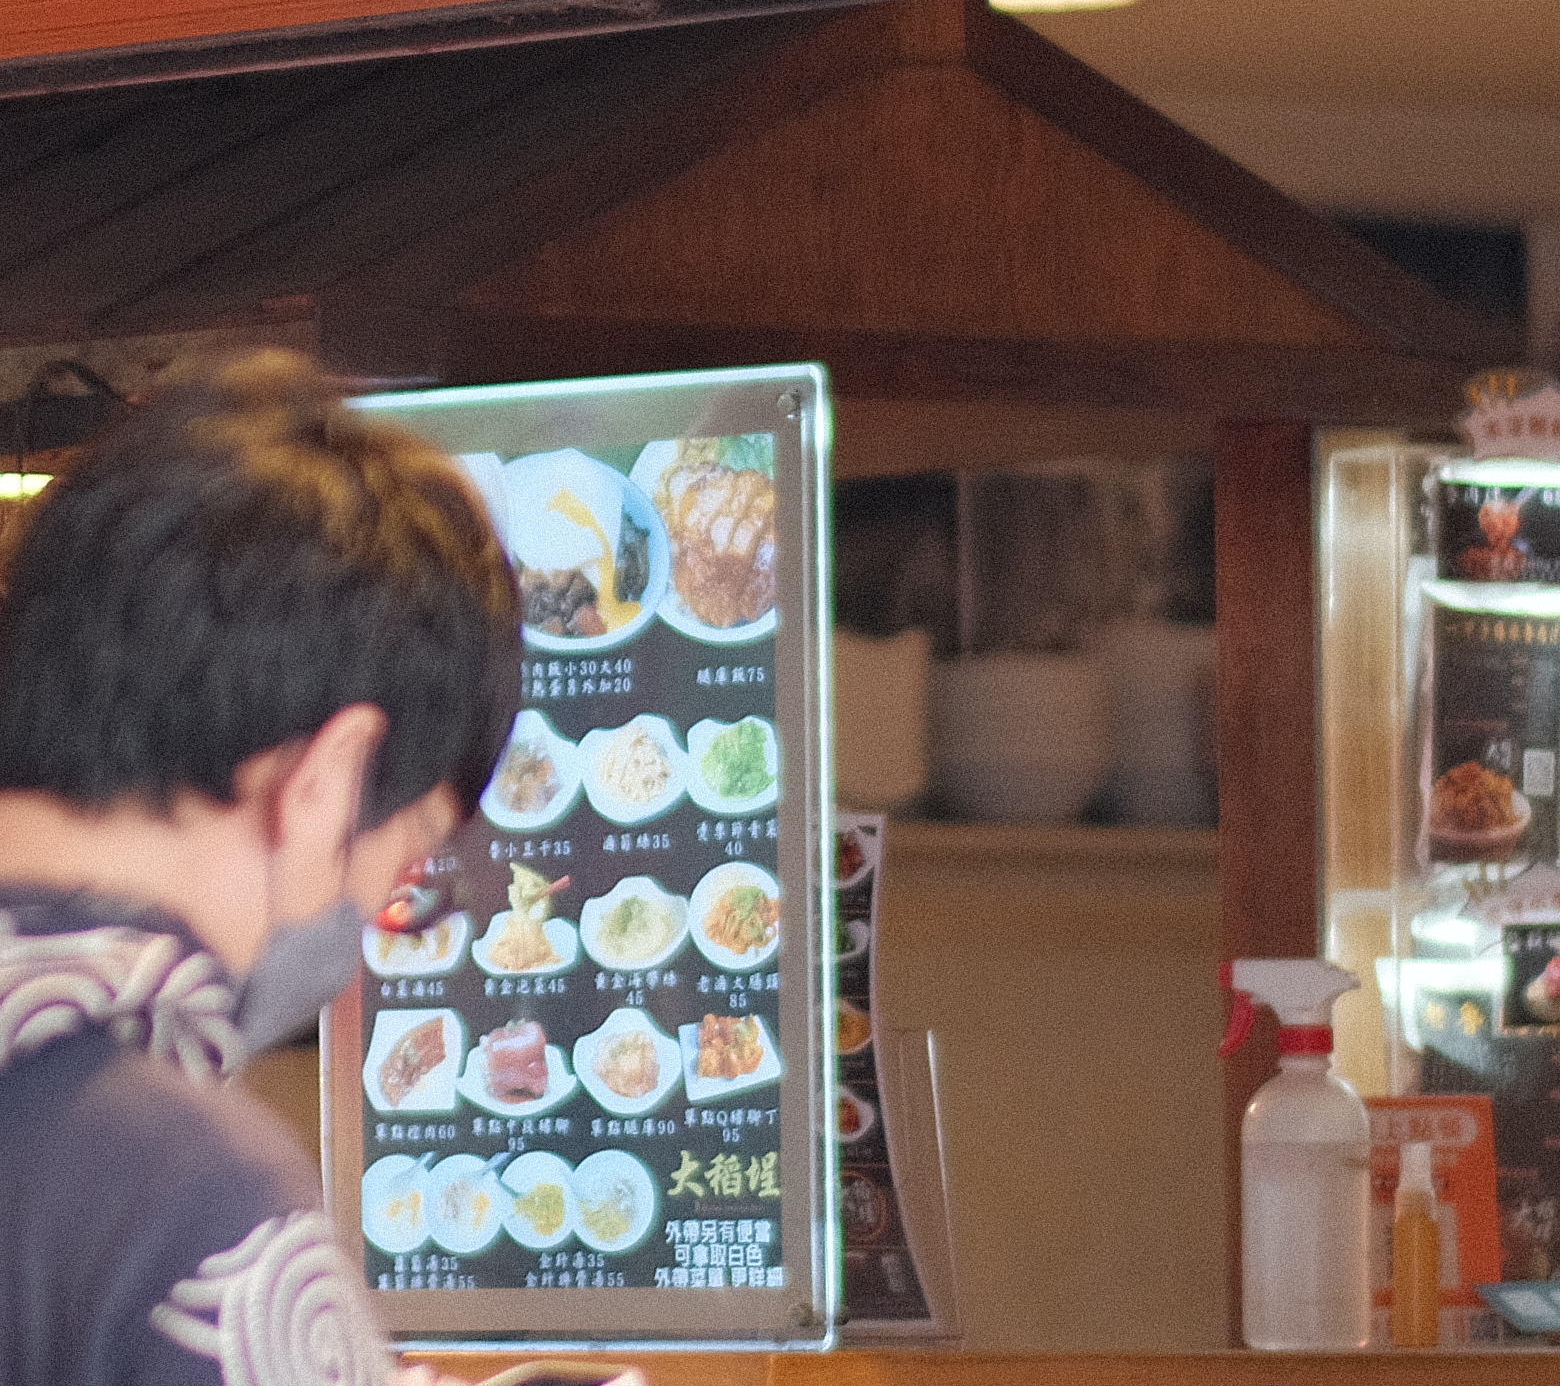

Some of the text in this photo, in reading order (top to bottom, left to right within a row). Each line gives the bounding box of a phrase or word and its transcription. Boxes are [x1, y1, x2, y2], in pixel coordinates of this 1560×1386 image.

[520, 658, 633, 679] 肉飯小30大40
[724, 840, 744, 857] 40
[625, 990, 645, 1006] 45
[728, 993, 748, 1009] 85
[666, 1149, 782, 1199] 大稻埕
